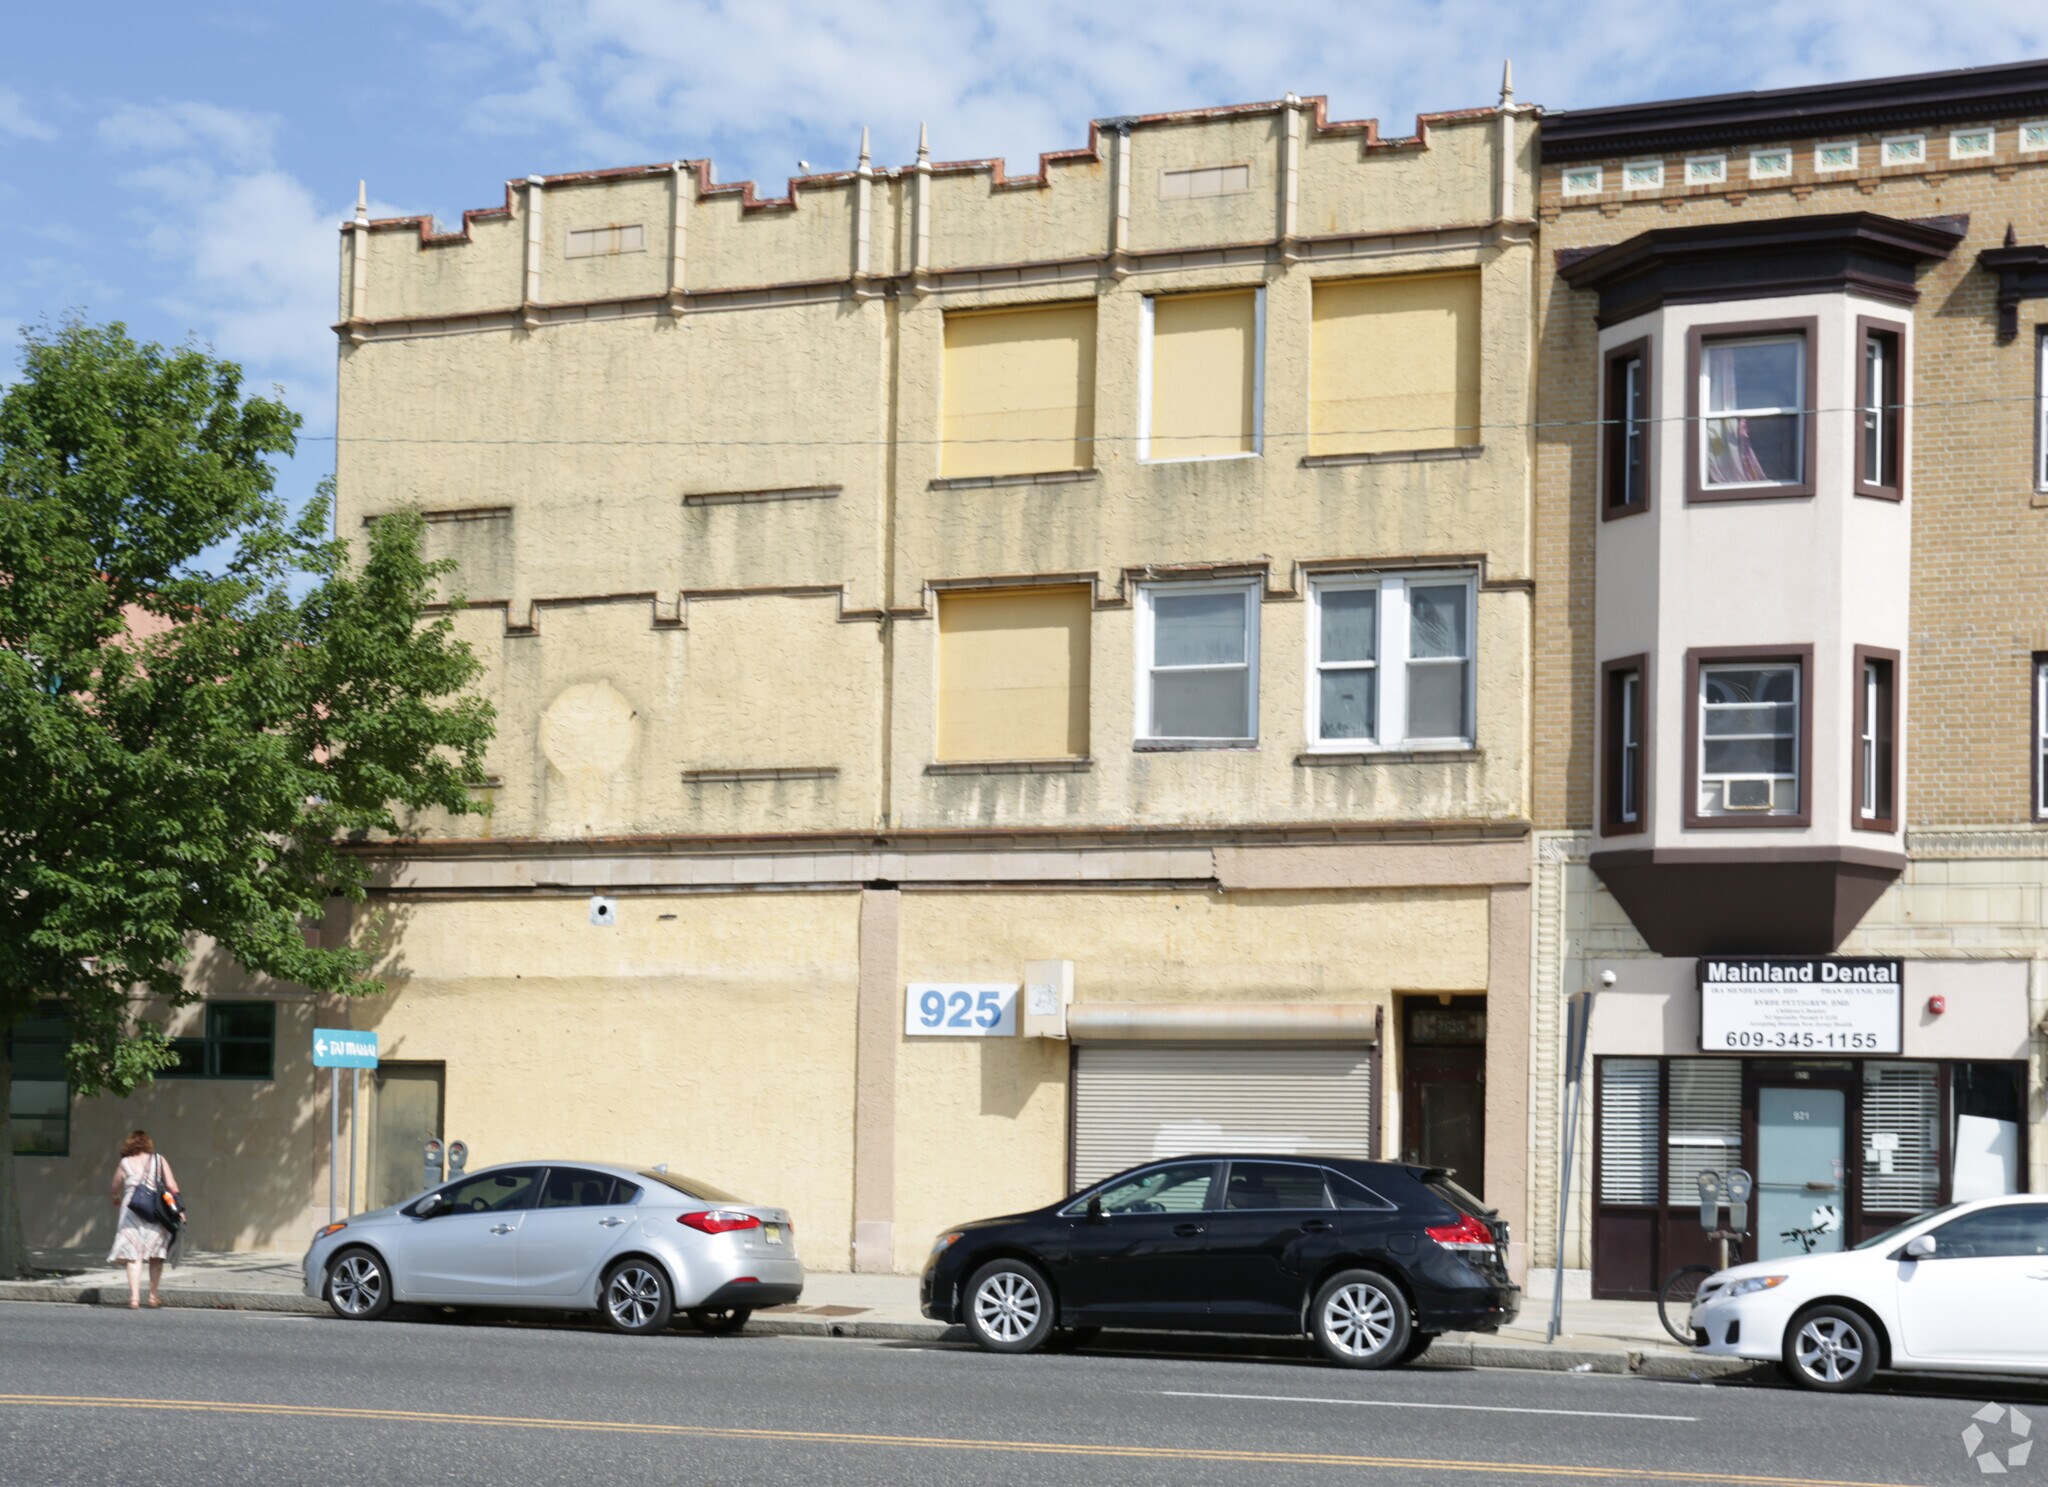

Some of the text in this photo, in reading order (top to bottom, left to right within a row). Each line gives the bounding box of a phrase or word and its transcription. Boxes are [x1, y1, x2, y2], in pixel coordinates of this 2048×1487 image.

[1708, 962, 1897, 982] Mainland Dental
[920, 990, 1001, 1028] 925
[1726, 1031, 1877, 1049] 609-345-1155
